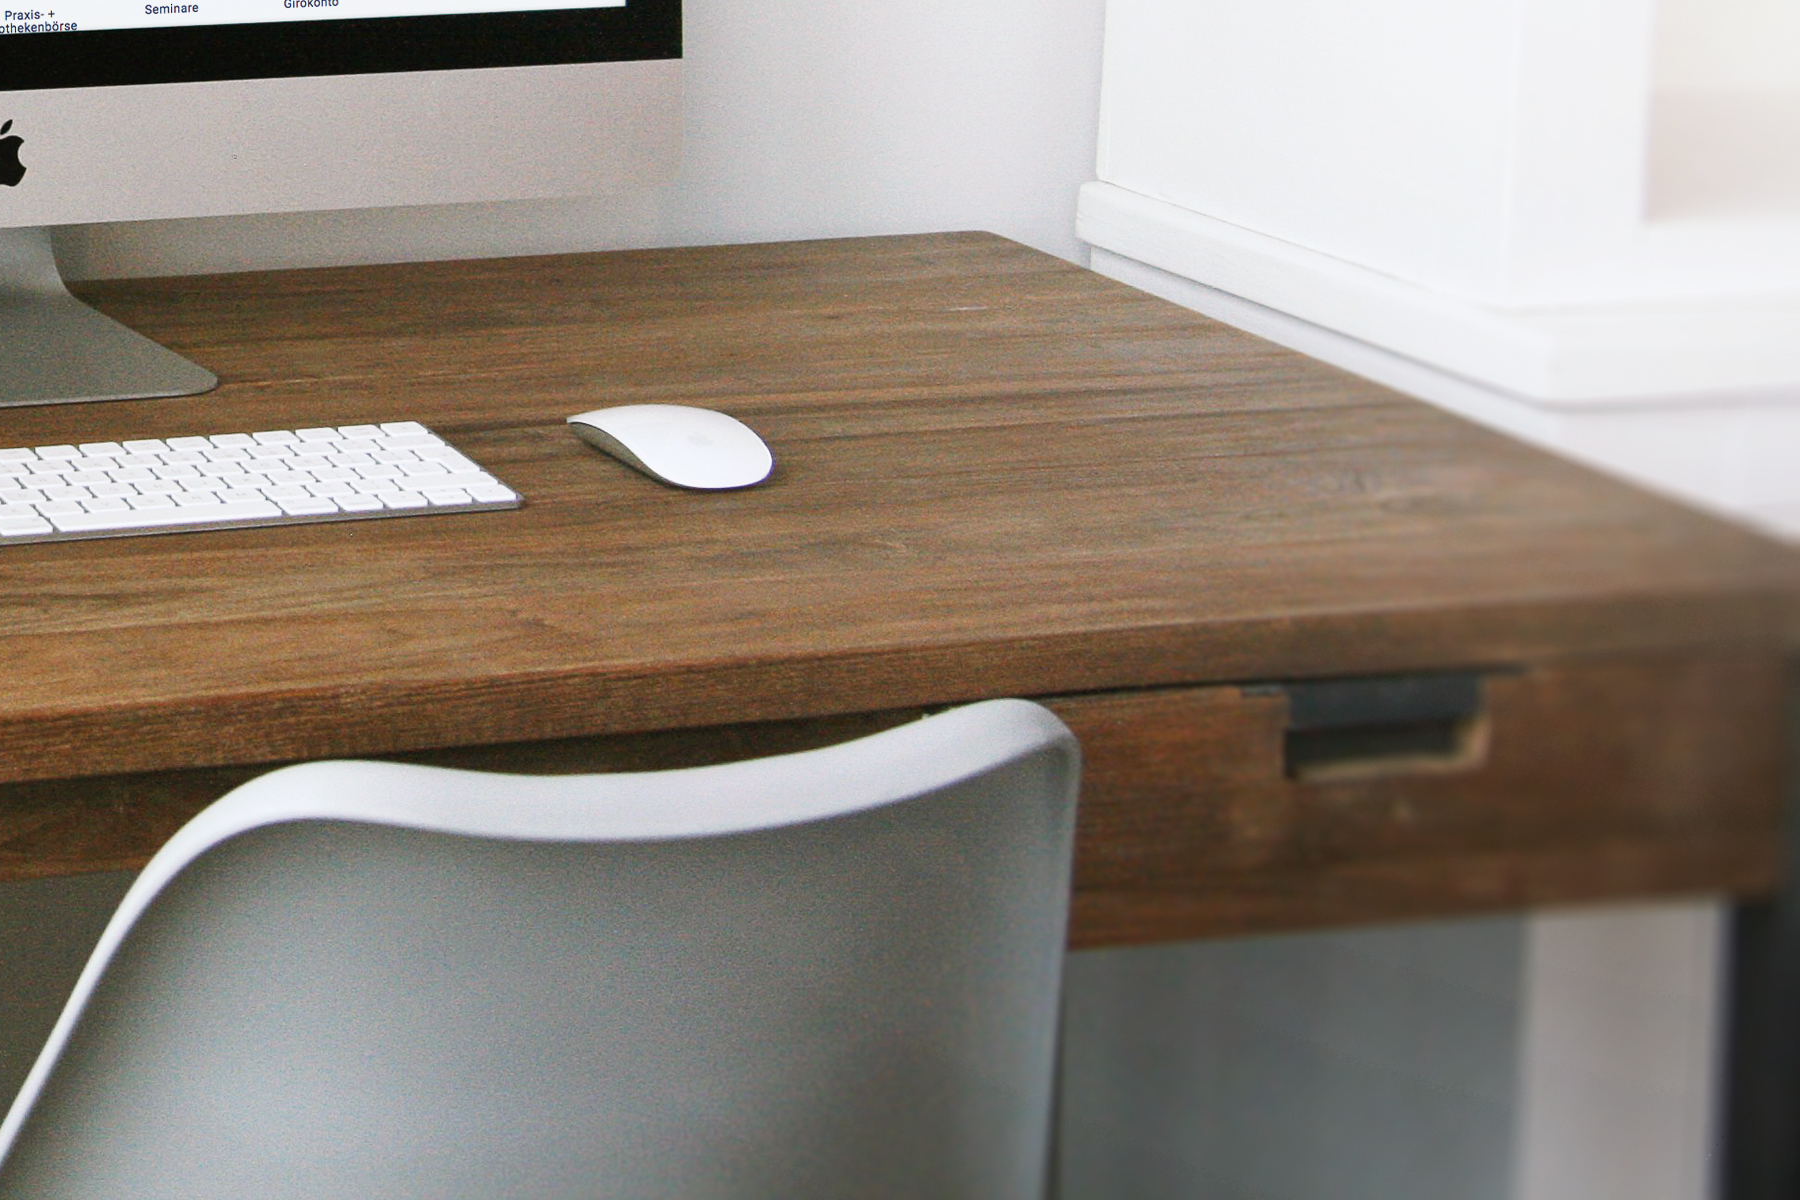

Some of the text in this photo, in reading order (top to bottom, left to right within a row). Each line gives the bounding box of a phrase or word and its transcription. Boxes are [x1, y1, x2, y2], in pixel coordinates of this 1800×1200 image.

[5, 9, 55, 21] Praxis- +
[144, 3, 199, 15] Seminare
